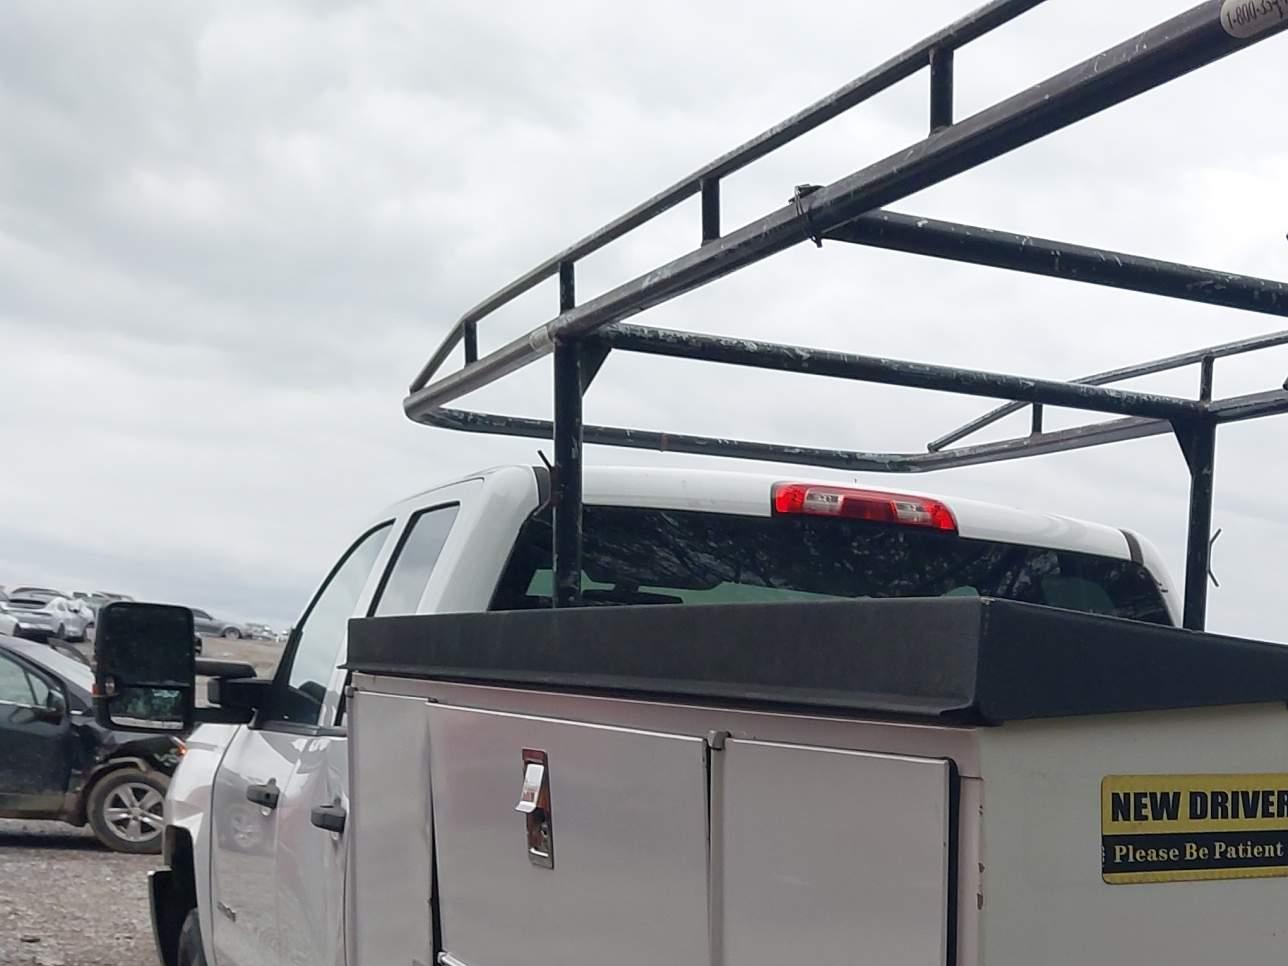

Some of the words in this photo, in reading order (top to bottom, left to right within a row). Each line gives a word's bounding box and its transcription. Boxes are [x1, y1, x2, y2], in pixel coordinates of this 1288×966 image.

[1111, 790, 1181, 822] NEW
[1113, 844, 1179, 863] Please
[1184, 842, 1209, 861] Be
[1214, 839, 1285, 859] Patient
